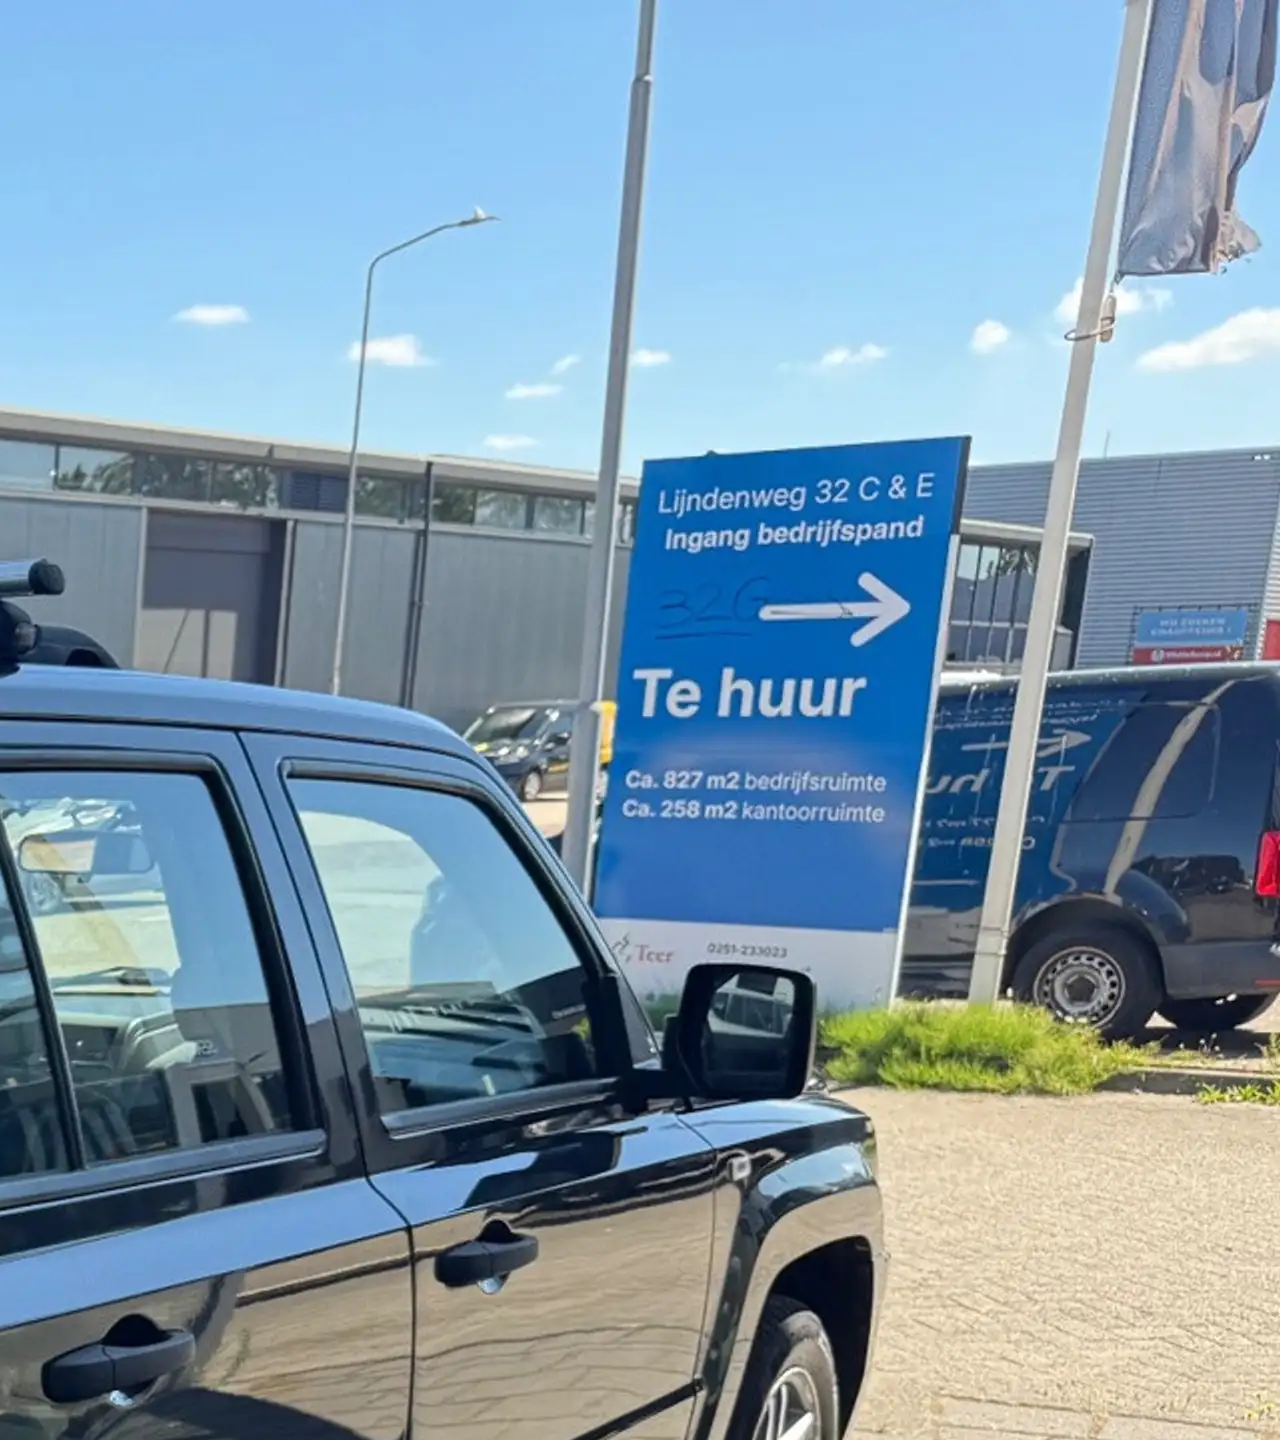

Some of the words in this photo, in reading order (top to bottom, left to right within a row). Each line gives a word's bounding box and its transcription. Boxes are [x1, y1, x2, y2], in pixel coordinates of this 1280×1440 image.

[657, 486, 807, 518] Lijndenweg
[814, 478, 851, 504] 32
[858, 476, 882, 501] C
[888, 474, 908, 500] &
[916, 472, 936, 498] E
[664, 527, 750, 554] Ingang
[757, 514, 925, 548] bedrijfspand
[632, 668, 702, 719] Te
[717, 666, 868, 718] huur
[625, 769, 659, 790] Ca.
[663, 770, 703, 790] 827
[707, 771, 740, 790] m2
[744, 771, 888, 795] bedrijfsruimte
[622, 799, 655, 818] Ca.
[660, 800, 701, 819] 258
[704, 801, 738, 819] m2
[742, 801, 887, 823] kantoorruimte
